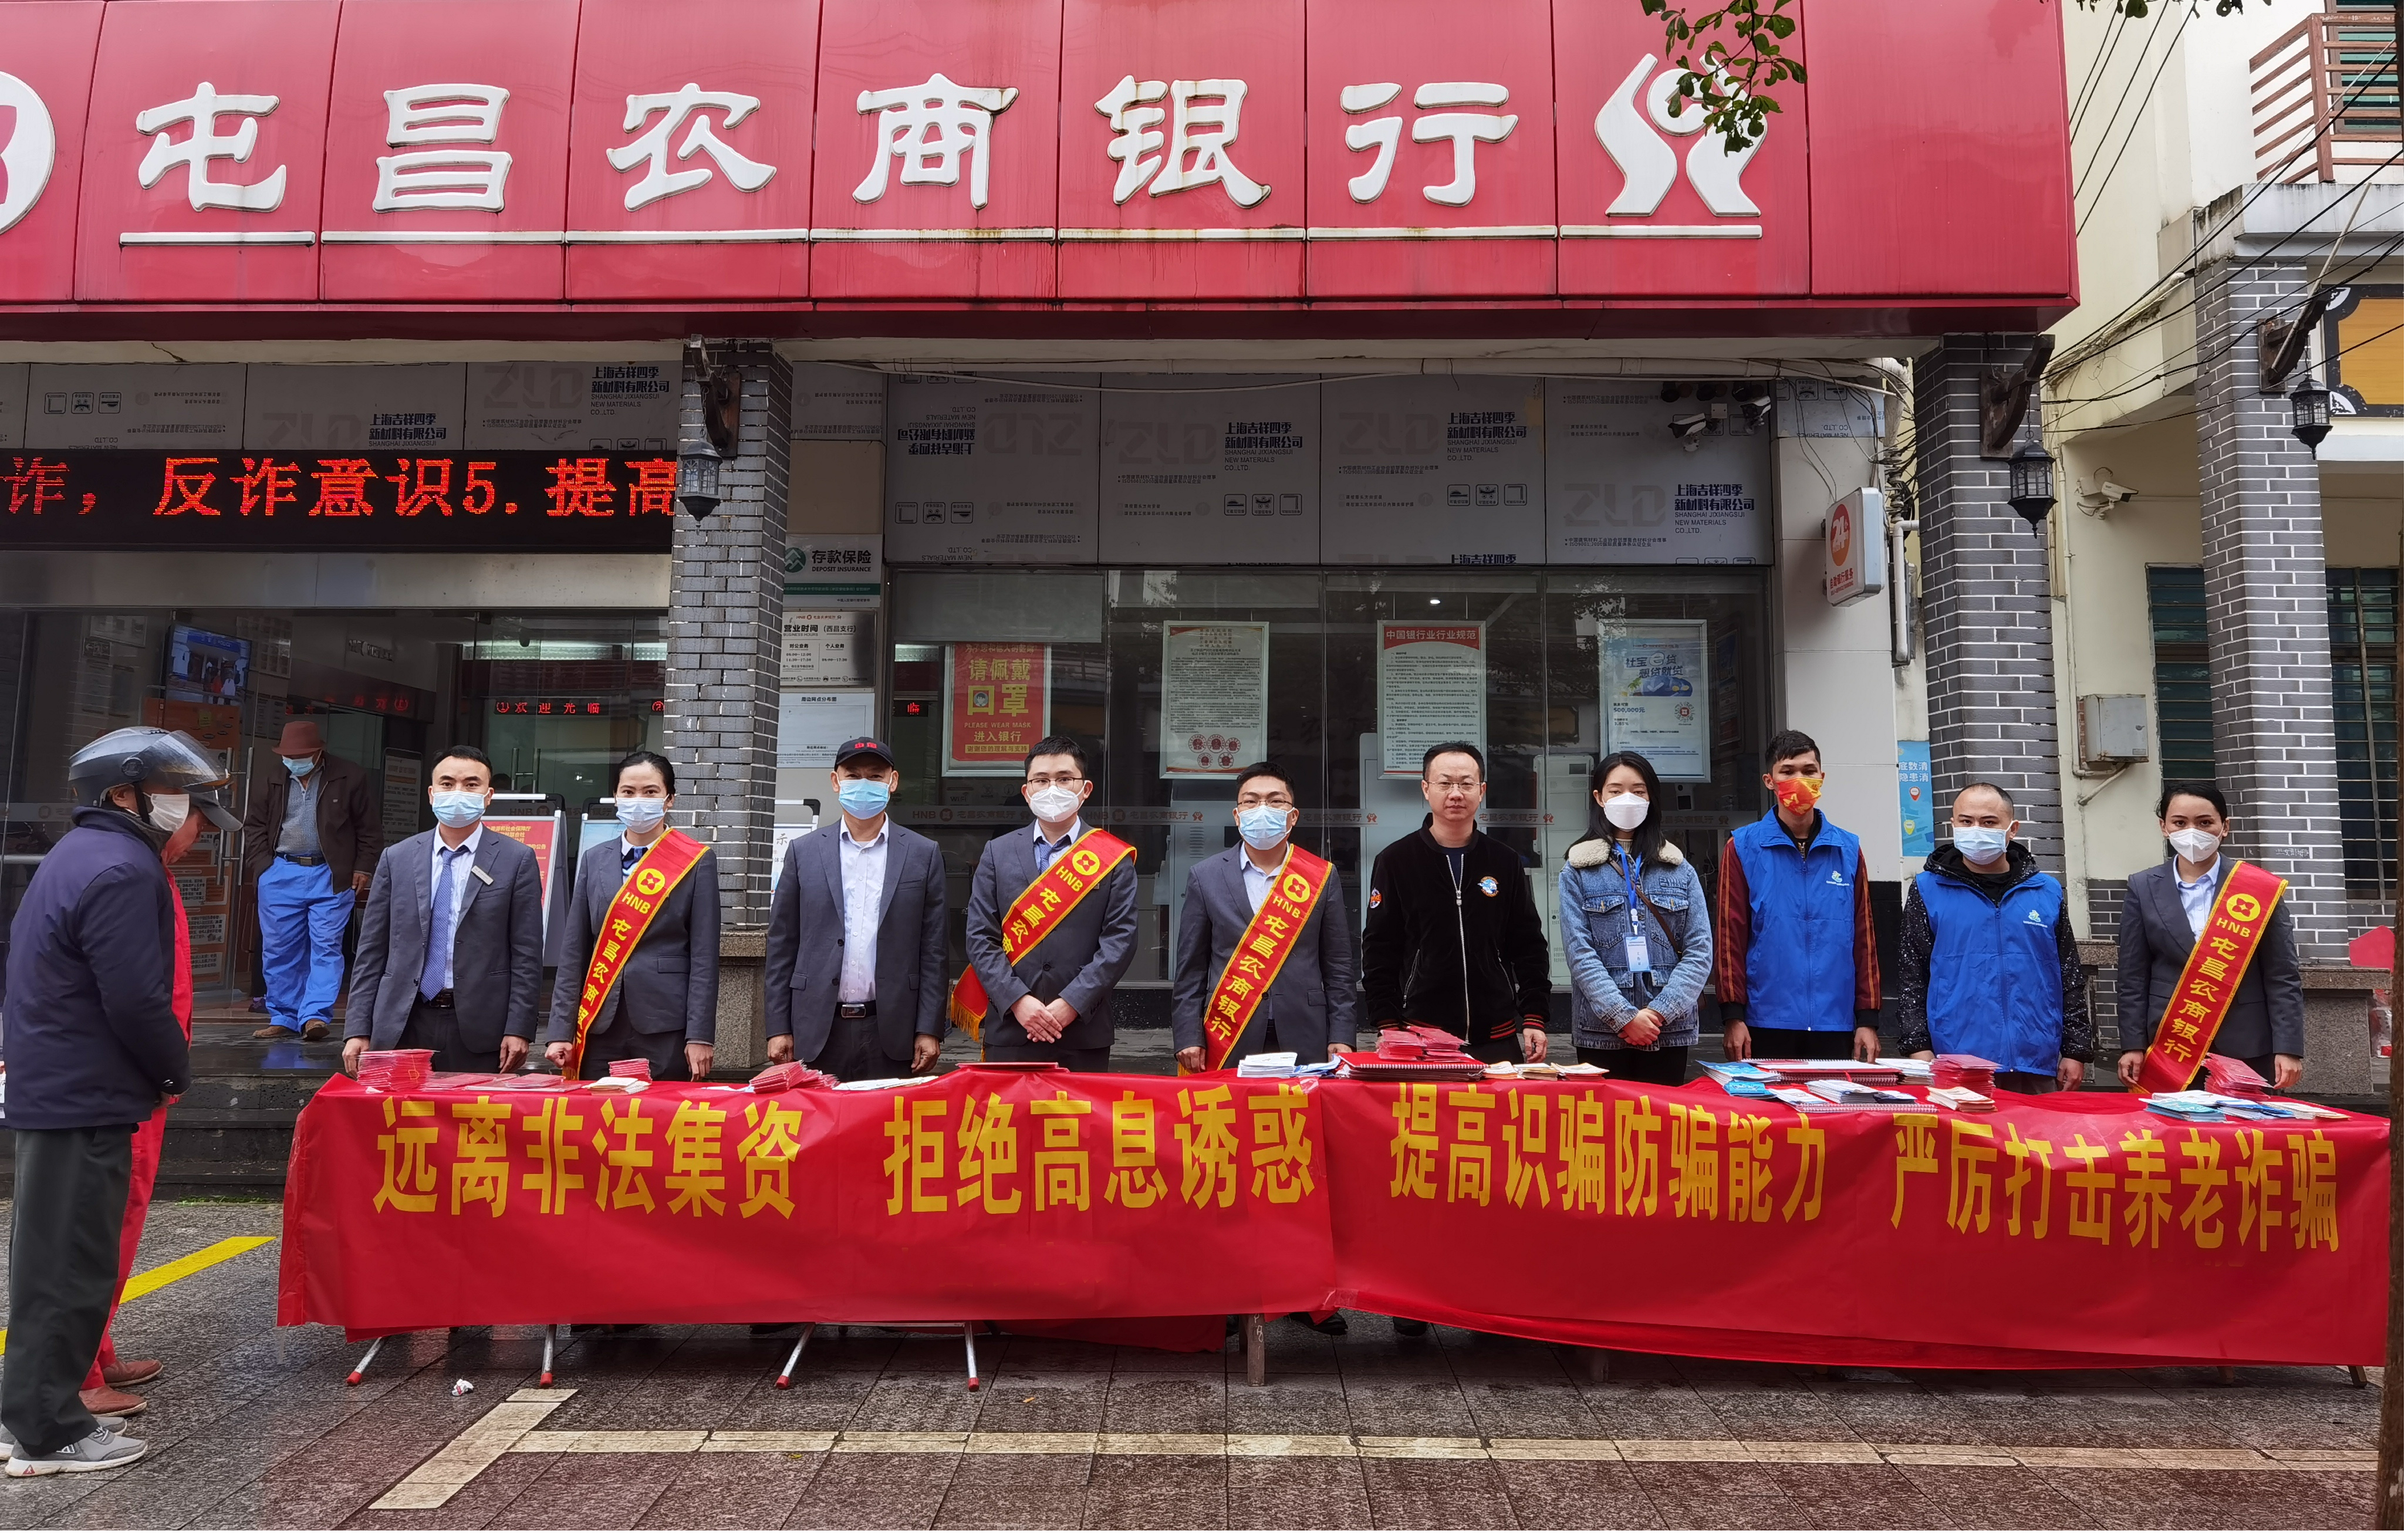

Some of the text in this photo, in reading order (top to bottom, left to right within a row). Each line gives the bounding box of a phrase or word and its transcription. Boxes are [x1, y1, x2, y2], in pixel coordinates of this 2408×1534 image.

[136, 72, 1518, 213] 屯昌农商银行
[592, 367, 659, 379] 上海吉祥四季
[592, 380, 670, 393] 新材料有限公司
[369, 413, 436, 425] 上海吉祥四季
[1447, 412, 1516, 424] 上海吉祥四季
[369, 427, 447, 440] 新材料有限公司
[1225, 422, 1292, 434] 上海吉祥四季
[1447, 426, 1527, 438] 新材料有限公司
[897, 428, 975, 441] 新材料有限公司
[1225, 436, 1303, 448] 新材料有限公司
[908, 443, 975, 455] 上海吉祥四季
[1675, 484, 1743, 496] 上海吉祥四季
[1675, 499, 1755, 511] 新材料有限公司
[812, 550, 872, 564] 存款保险
[1386, 630, 1477, 640] 中国银行业行业规范
[969, 658, 1031, 681] 请佩戴
[967, 684, 1029, 717] 口罩
[974, 731, 1022, 742] 进入银行
[1899, 761, 1927, 771] 底数清
[1899, 773, 1929, 782] 隐患消
[957, 811, 1016, 819] 屯昌农商银行
[1130, 812, 1188, 820] 屯昌农商银行
[1056, 866, 1084, 892] HNB
[622, 891, 651, 915] HNB
[1272, 895, 1301, 919] HNB
[2216, 917, 2251, 938] HNB
[1210, 914, 1290, 1042] 屯昌农商银行
[2164, 935, 2240, 1063] 屯昌农商银行
[373, 1083, 2338, 1253] 远离非法集资 拒绝高息诱惑 提高识骗防骗能力 严厉打击养老诈骗
